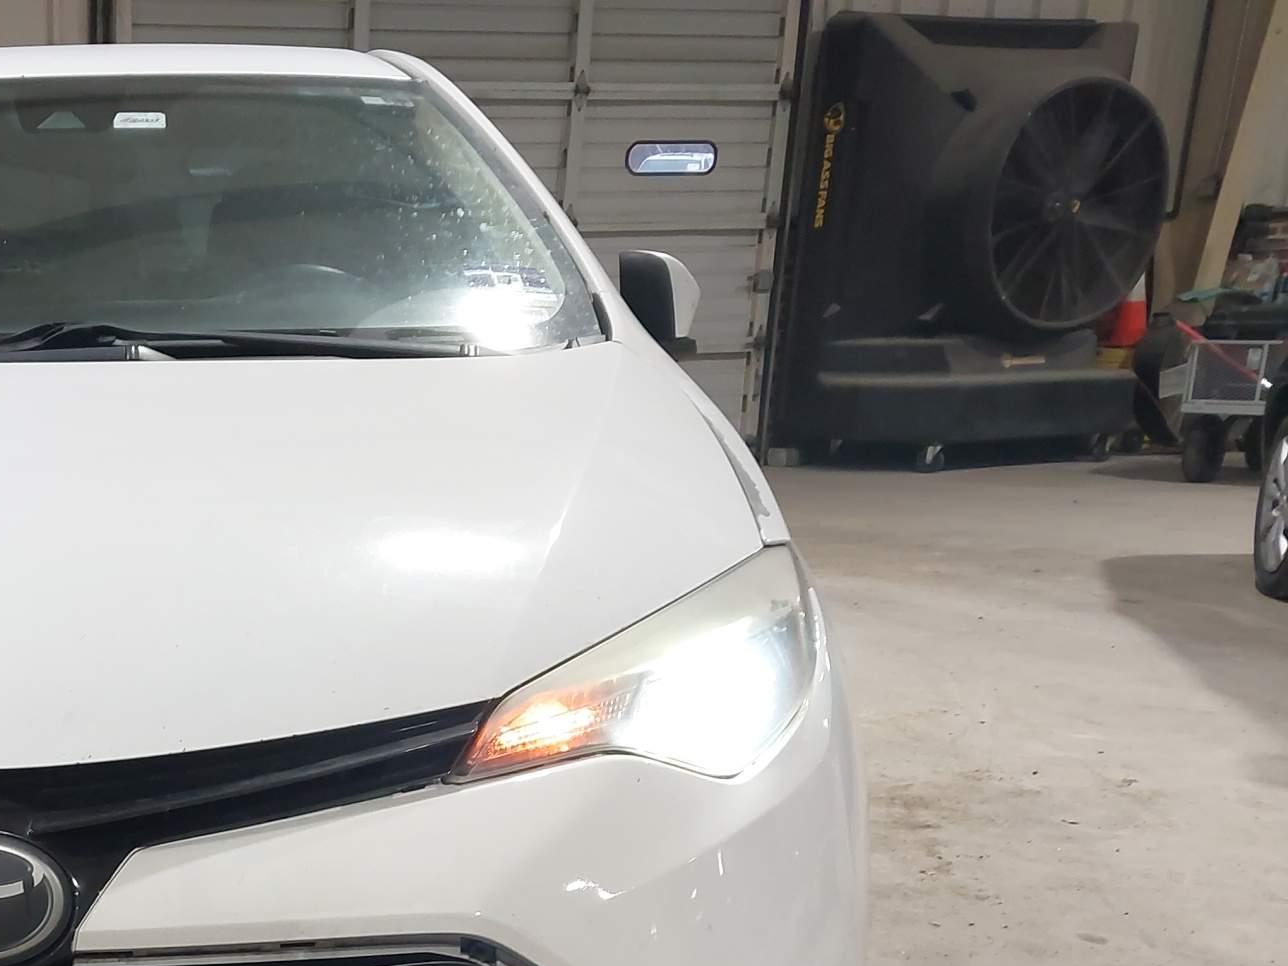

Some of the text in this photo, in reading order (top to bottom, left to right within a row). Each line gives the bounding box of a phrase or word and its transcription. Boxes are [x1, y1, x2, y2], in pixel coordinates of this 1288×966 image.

[814, 133, 835, 229] BIG ASS FANS
